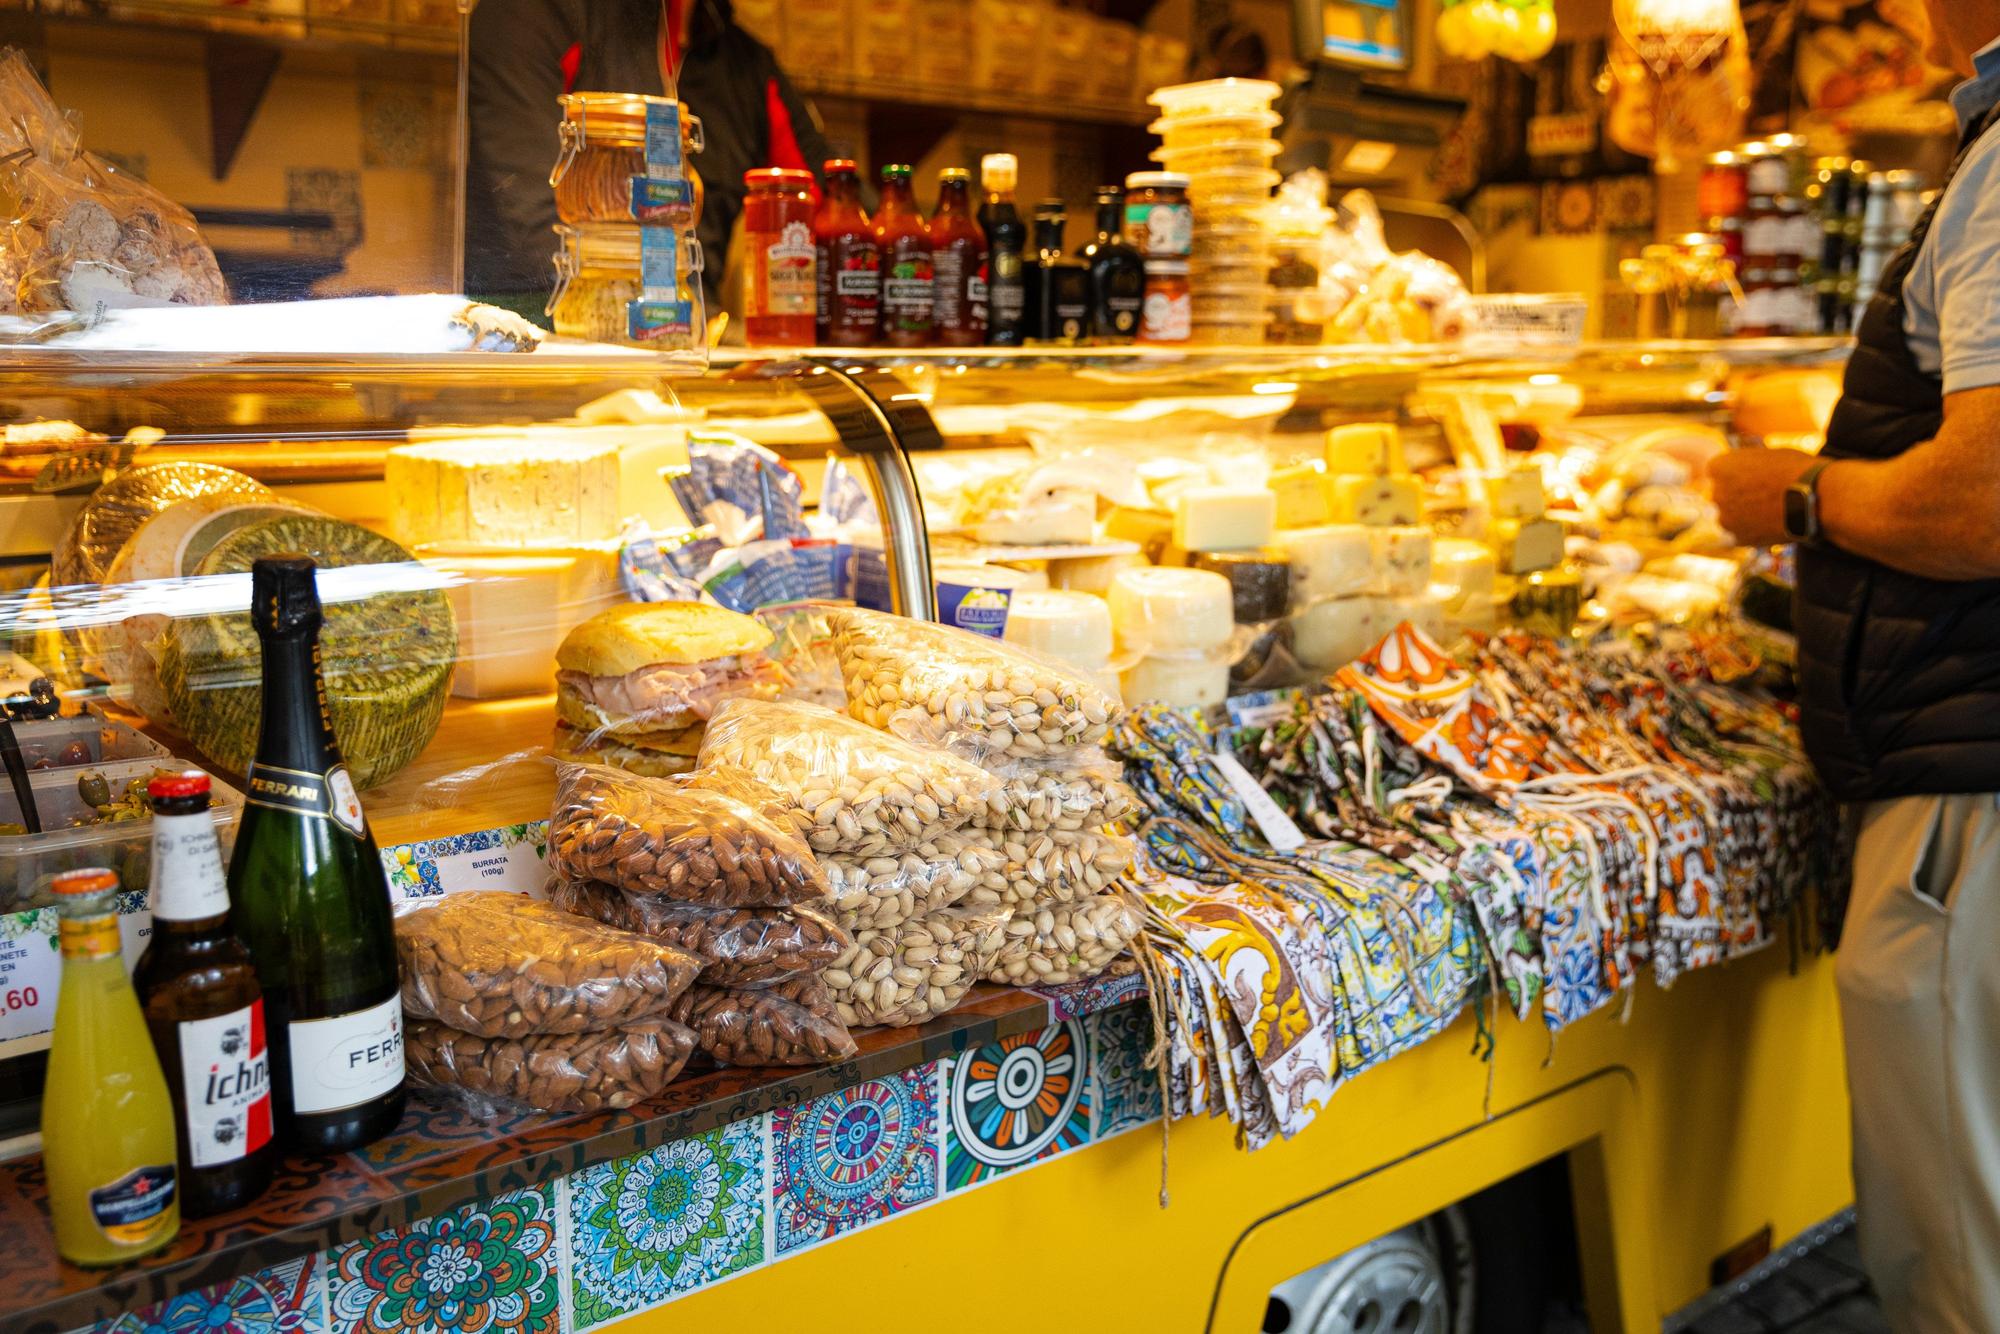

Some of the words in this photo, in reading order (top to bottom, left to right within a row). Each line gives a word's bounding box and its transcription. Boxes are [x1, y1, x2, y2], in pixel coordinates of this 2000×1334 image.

[251, 777, 319, 801] FERRARI
[472, 857, 508, 868] BURRATA
[481, 867, 504, 877] (100g)
[1, 962, 16, 972] EN
[349, 1032, 404, 1068] FERR
[205, 1050, 270, 1106] ichn
